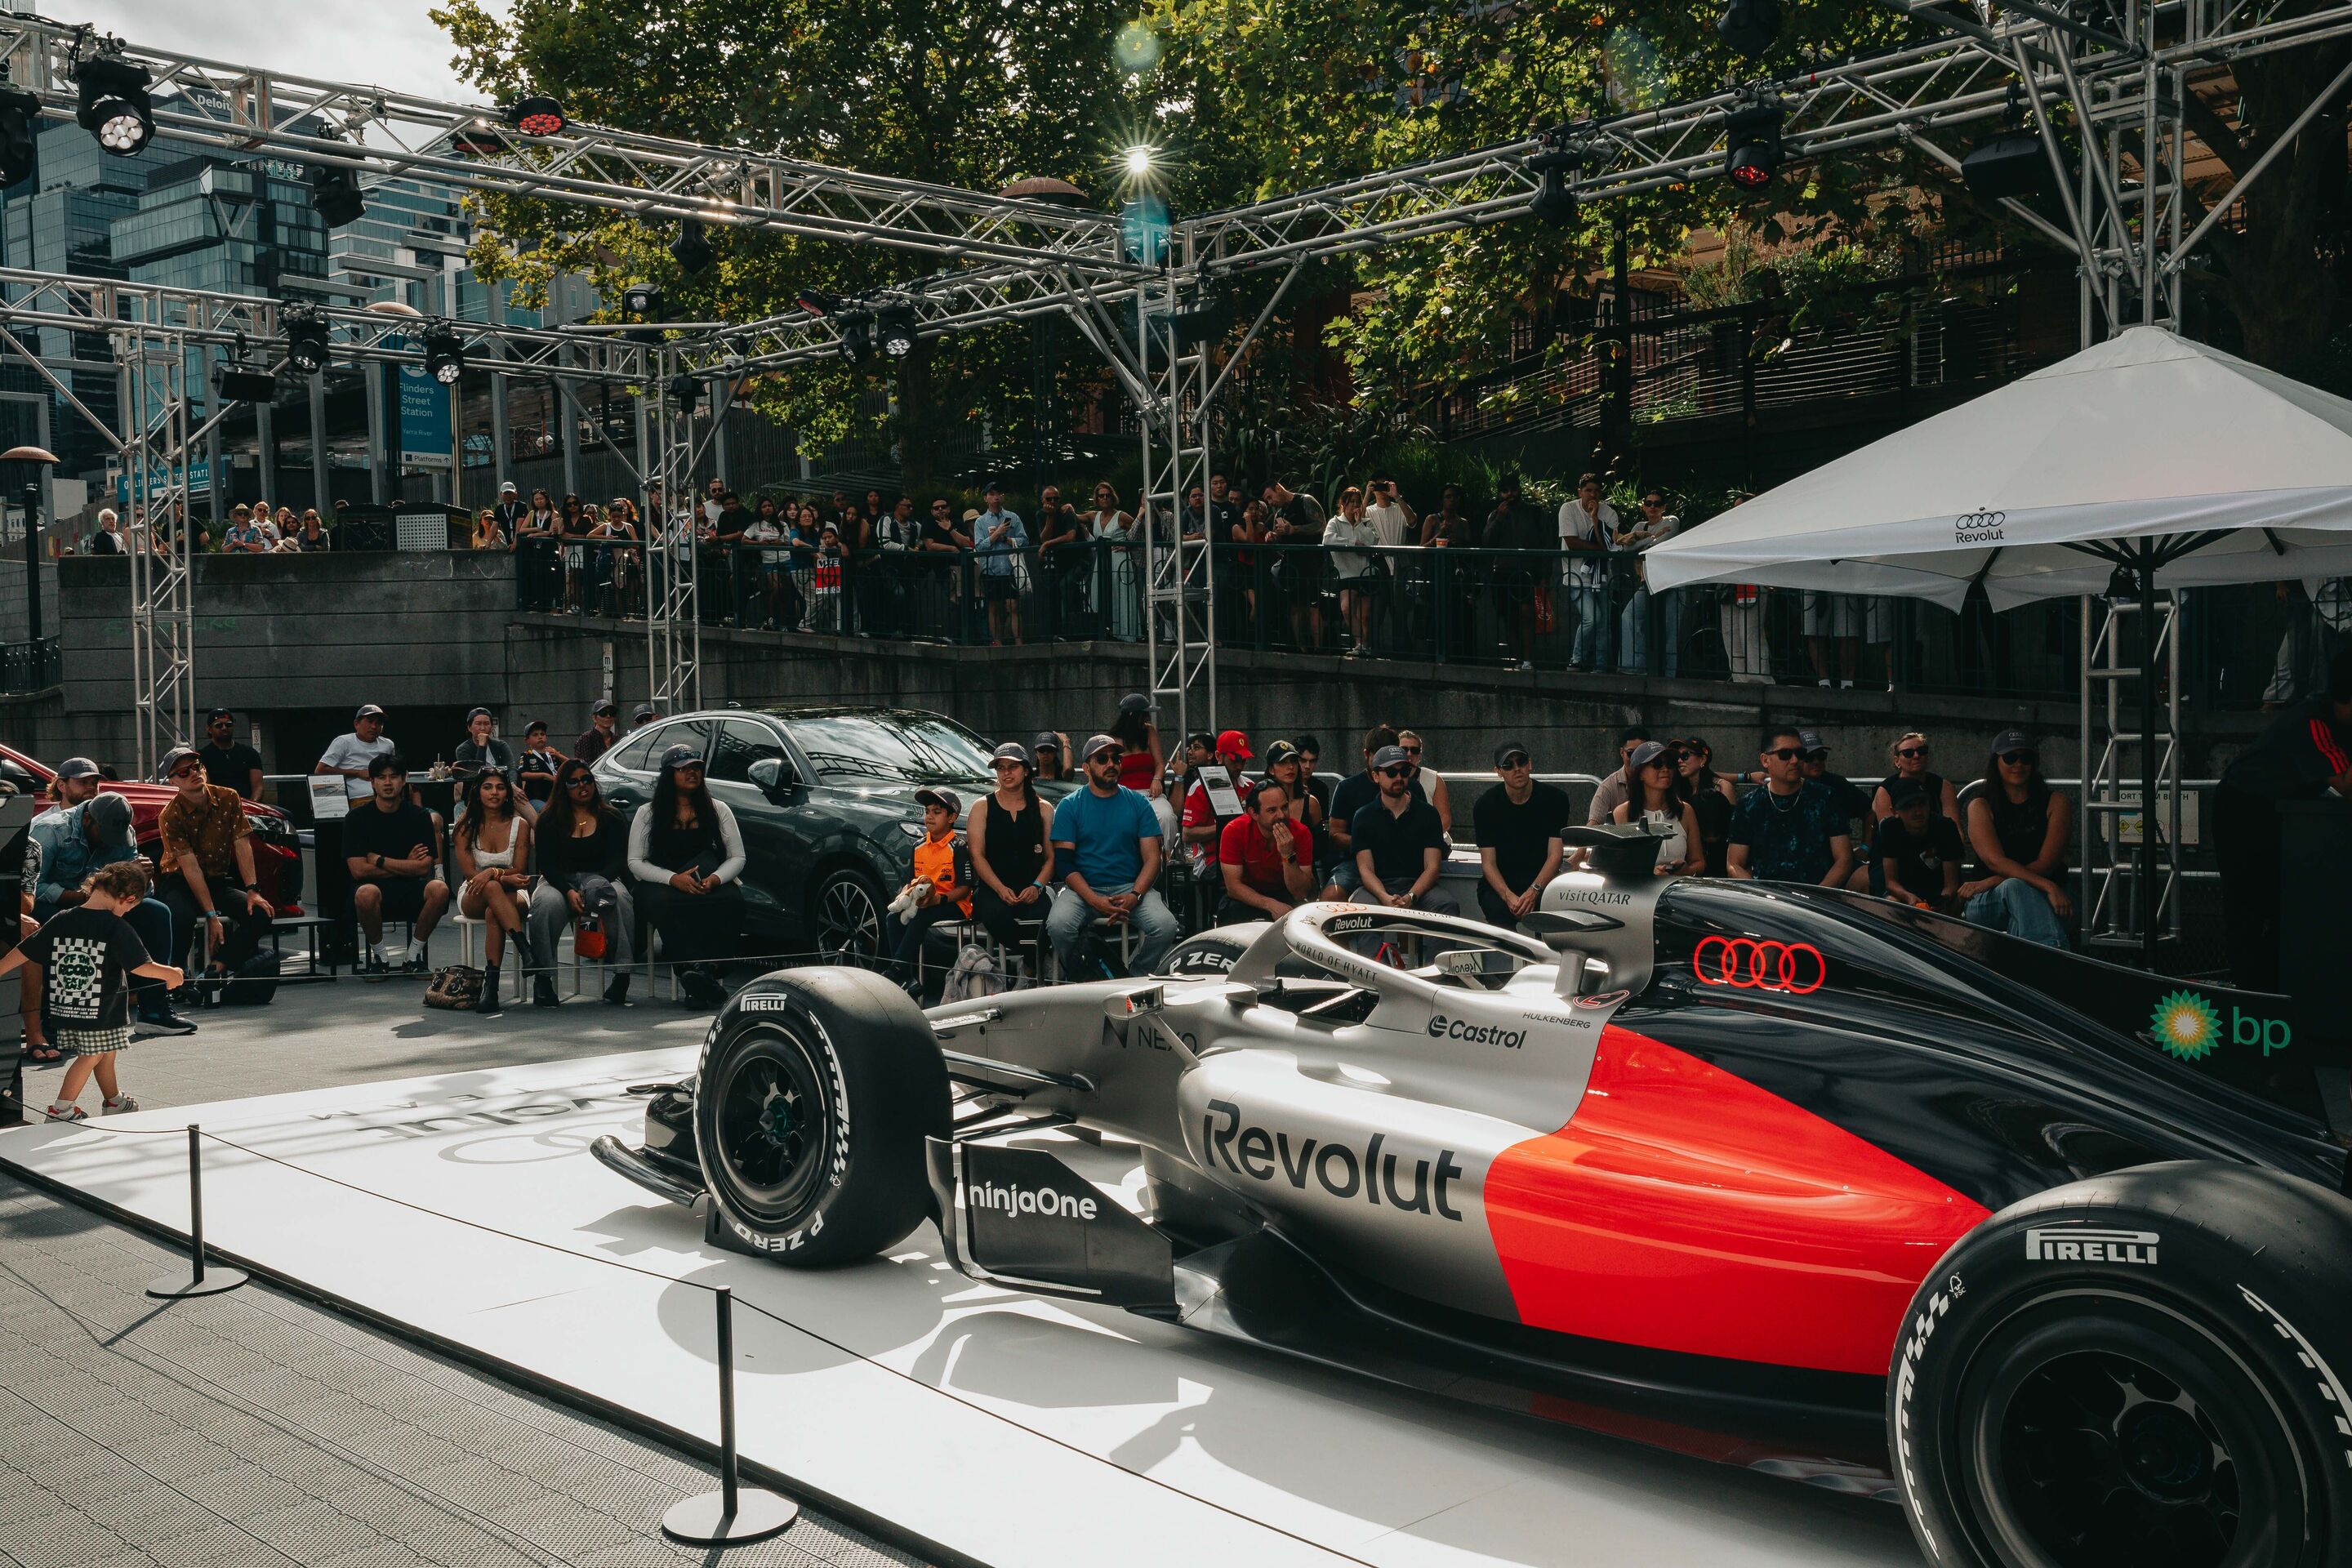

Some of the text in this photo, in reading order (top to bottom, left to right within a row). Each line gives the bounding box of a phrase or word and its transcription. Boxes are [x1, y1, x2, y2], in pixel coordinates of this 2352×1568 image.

[198, 94, 232, 111] Deloit
[402, 394, 431, 406] Street
[400, 407, 433, 417] Station
[414, 455, 442, 463] Platforms
[189, 469, 208, 479] STATI
[1955, 528, 2004, 544] Revolut
[1559, 889, 1631, 906] visitQATAR
[1334, 915, 1373, 932] Revolut
[1169, 951, 1236, 976] P ZER
[1295, 941, 1378, 982] WORLD OF HYATT
[740, 992, 787, 1012] PIRELLI
[1522, 1012, 1592, 1029] HULKENBERG
[1449, 1019, 1527, 1049] Castrol
[2233, 1005, 2292, 1058] bp
[1203, 1098, 1463, 1223] Revolut
[969, 1180, 1098, 1220] ninjaOne
[734, 1209, 824, 1252] P ZERO
[2025, 1228, 2160, 1265] PIRELLI
